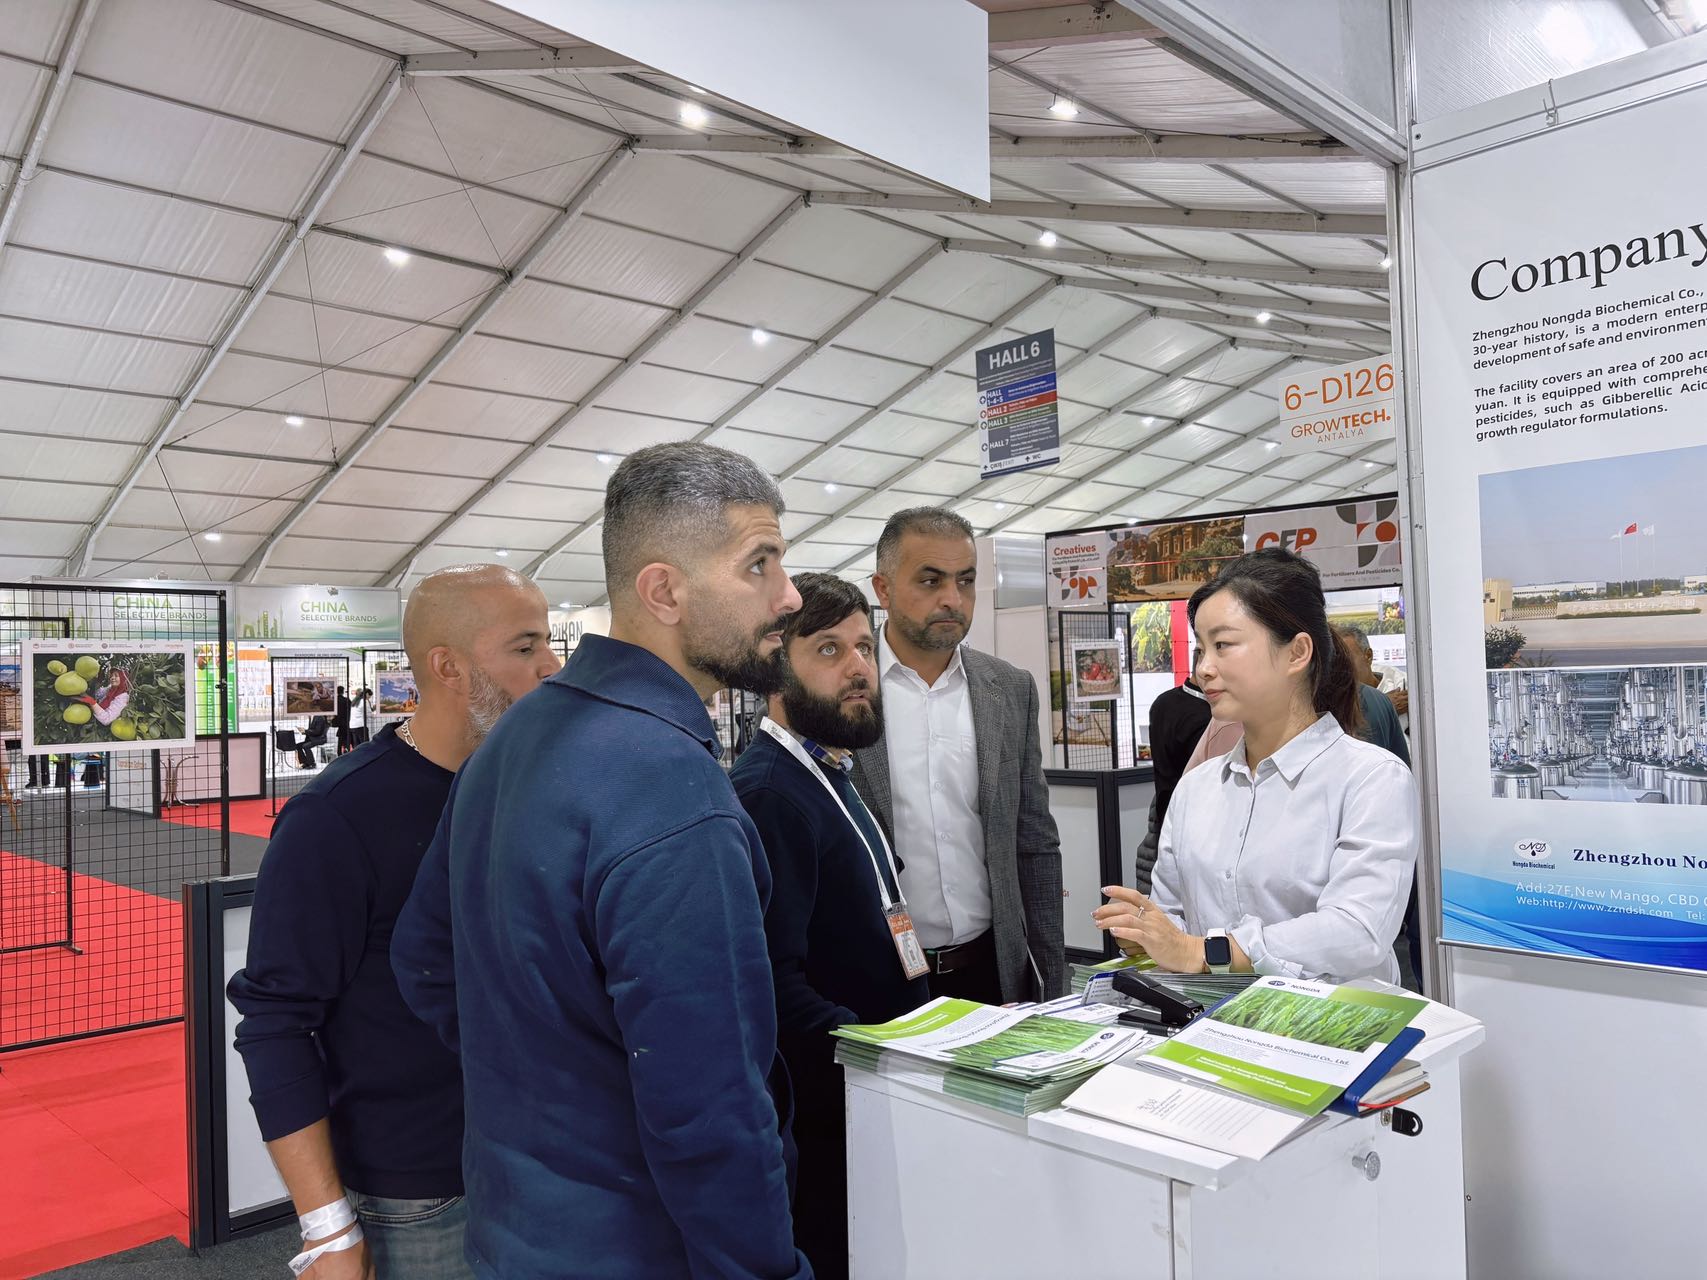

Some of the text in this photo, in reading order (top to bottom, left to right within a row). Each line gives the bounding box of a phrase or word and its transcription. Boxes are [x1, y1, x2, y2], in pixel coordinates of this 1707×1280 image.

[1472, 289, 1704, 341] Zhengzhou Nongda Biochemical Co.,
[1473, 340, 1518, 355] 30-year
[1524, 330, 1569, 345] history,
[1575, 325, 1585, 335] is
[1592, 323, 1600, 331] a
[1607, 312, 1658, 329] modern
[1473, 317, 1707, 370] development of safe and environmen
[989, 345, 1029, 370] HALL
[1030, 341, 1040, 357] 6
[1474, 388, 1496, 398] The
[1499, 379, 1539, 394] facility
[1542, 371, 1583, 385] covers
[1587, 368, 1603, 378] an
[1607, 362, 1637, 375] area
[1642, 356, 1656, 368] of
[1660, 352, 1684, 366] 200
[987, 389, 1002, 398] HALL
[1285, 363, 1393, 410] 6-D126
[1475, 400, 1508, 414] yuan.
[1513, 396, 1522, 405] It
[1526, 394, 1536, 403] is
[1542, 381, 1602, 401] equipped
[1608, 376, 1637, 389] with
[988, 407, 1002, 416] HALL
[1475, 409, 1537, 428] pesticides,
[1544, 402, 1573, 415] such
[1580, 399, 1595, 409] as
[1602, 386, 1673, 406] Gibberellic
[988, 418, 1003, 427] HALL
[1291, 408, 1391, 438] GROWTECH.
[1476, 404, 1668, 442] growth regulator formulations.
[1317, 428, 1364, 443] ANTALYA
[989, 440, 1004, 449] HALL
[1053, 544, 1097, 556] Creatives
[114, 595, 173, 609] CHINA
[300, 601, 349, 613] CHINA
[115, 610, 208, 620] SELECTIVE BRANDS
[300, 614, 343, 622] SELECTIVE
[1528, 862, 1555, 870] Biochemical
[1573, 849, 1707, 869] Zhengzhou No
[1610, 889, 1664, 905] Mango,
[1668, 893, 1699, 906] CBD
[1685, 910, 1705, 920] Tel:
[1274, 1045, 1319, 1060] Biochemical
